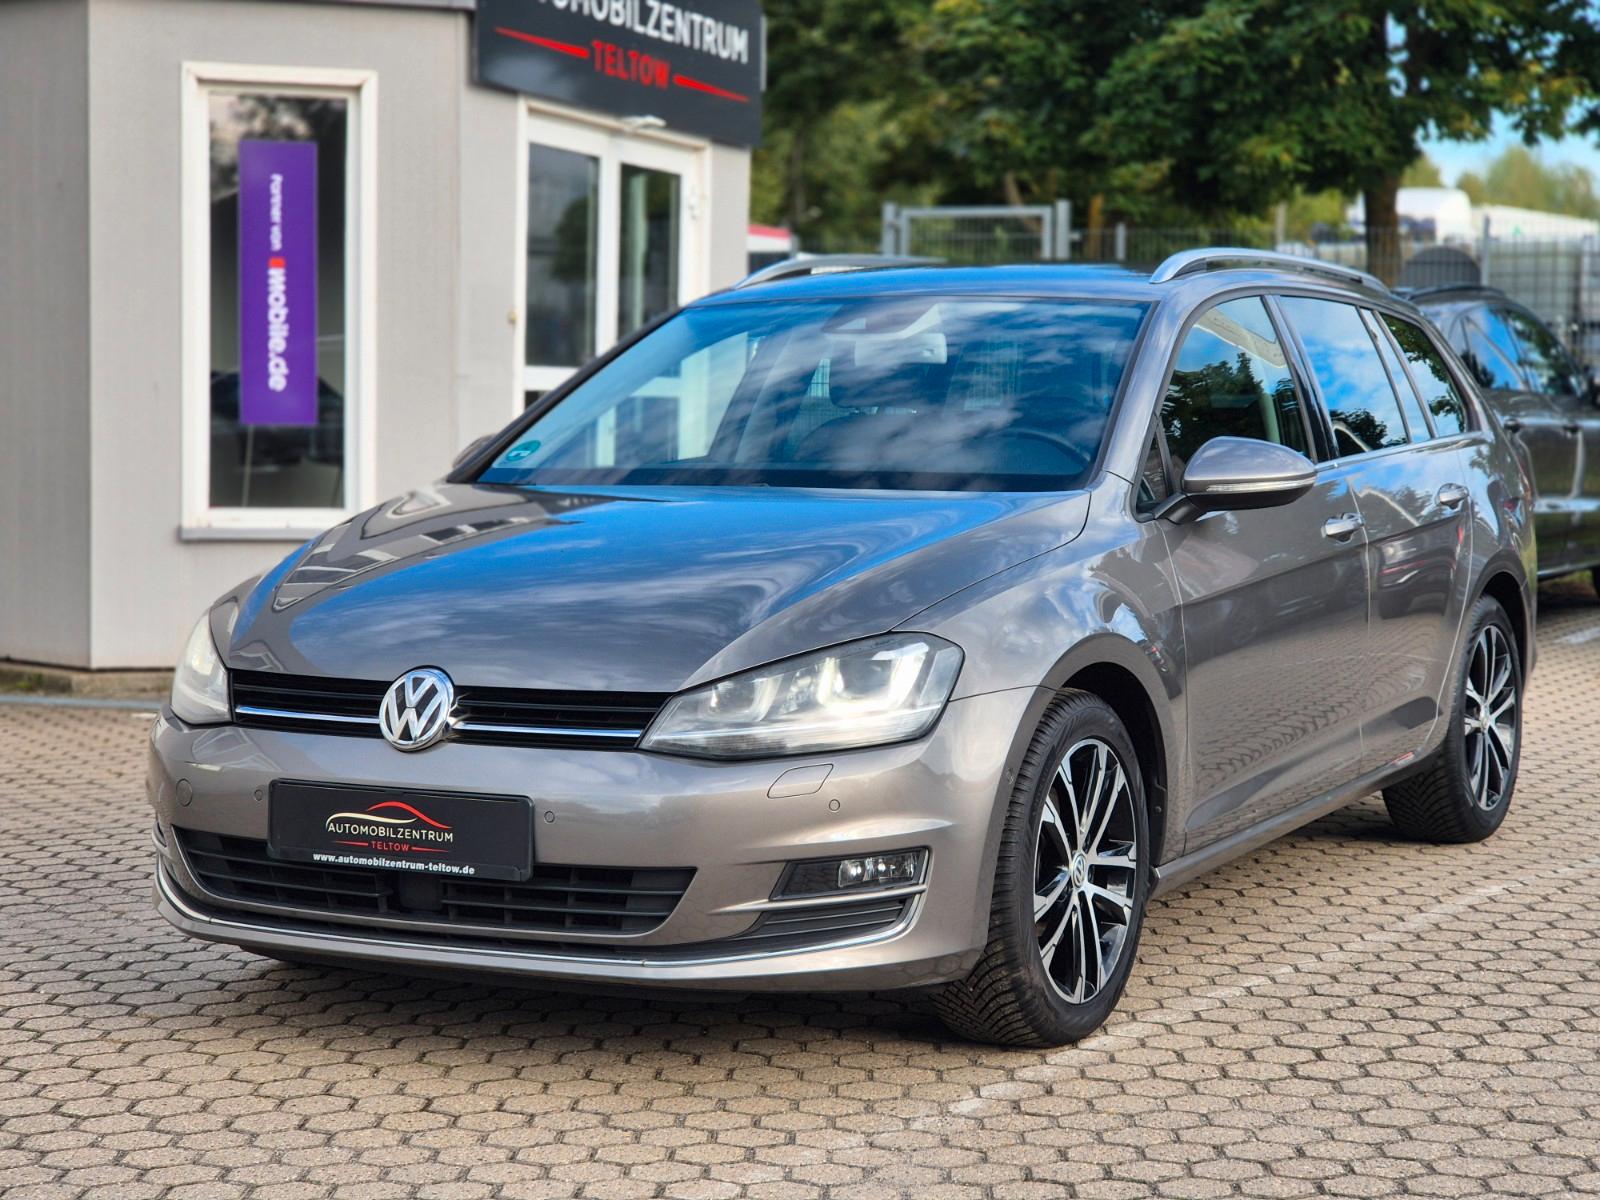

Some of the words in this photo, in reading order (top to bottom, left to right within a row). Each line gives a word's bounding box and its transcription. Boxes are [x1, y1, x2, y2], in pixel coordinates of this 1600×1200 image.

[541, 0, 748, 64] MOBILZENTRUM
[592, 40, 670, 89] TELTOW
[270, 225, 282, 251] von
[268, 267, 288, 391] mobile.de
[327, 823, 454, 843] AUTOMOBILZENTRUM
[371, 841, 411, 852] TELTOW
[312, 853, 475, 874] www.automobilzentrum-teltow.de
